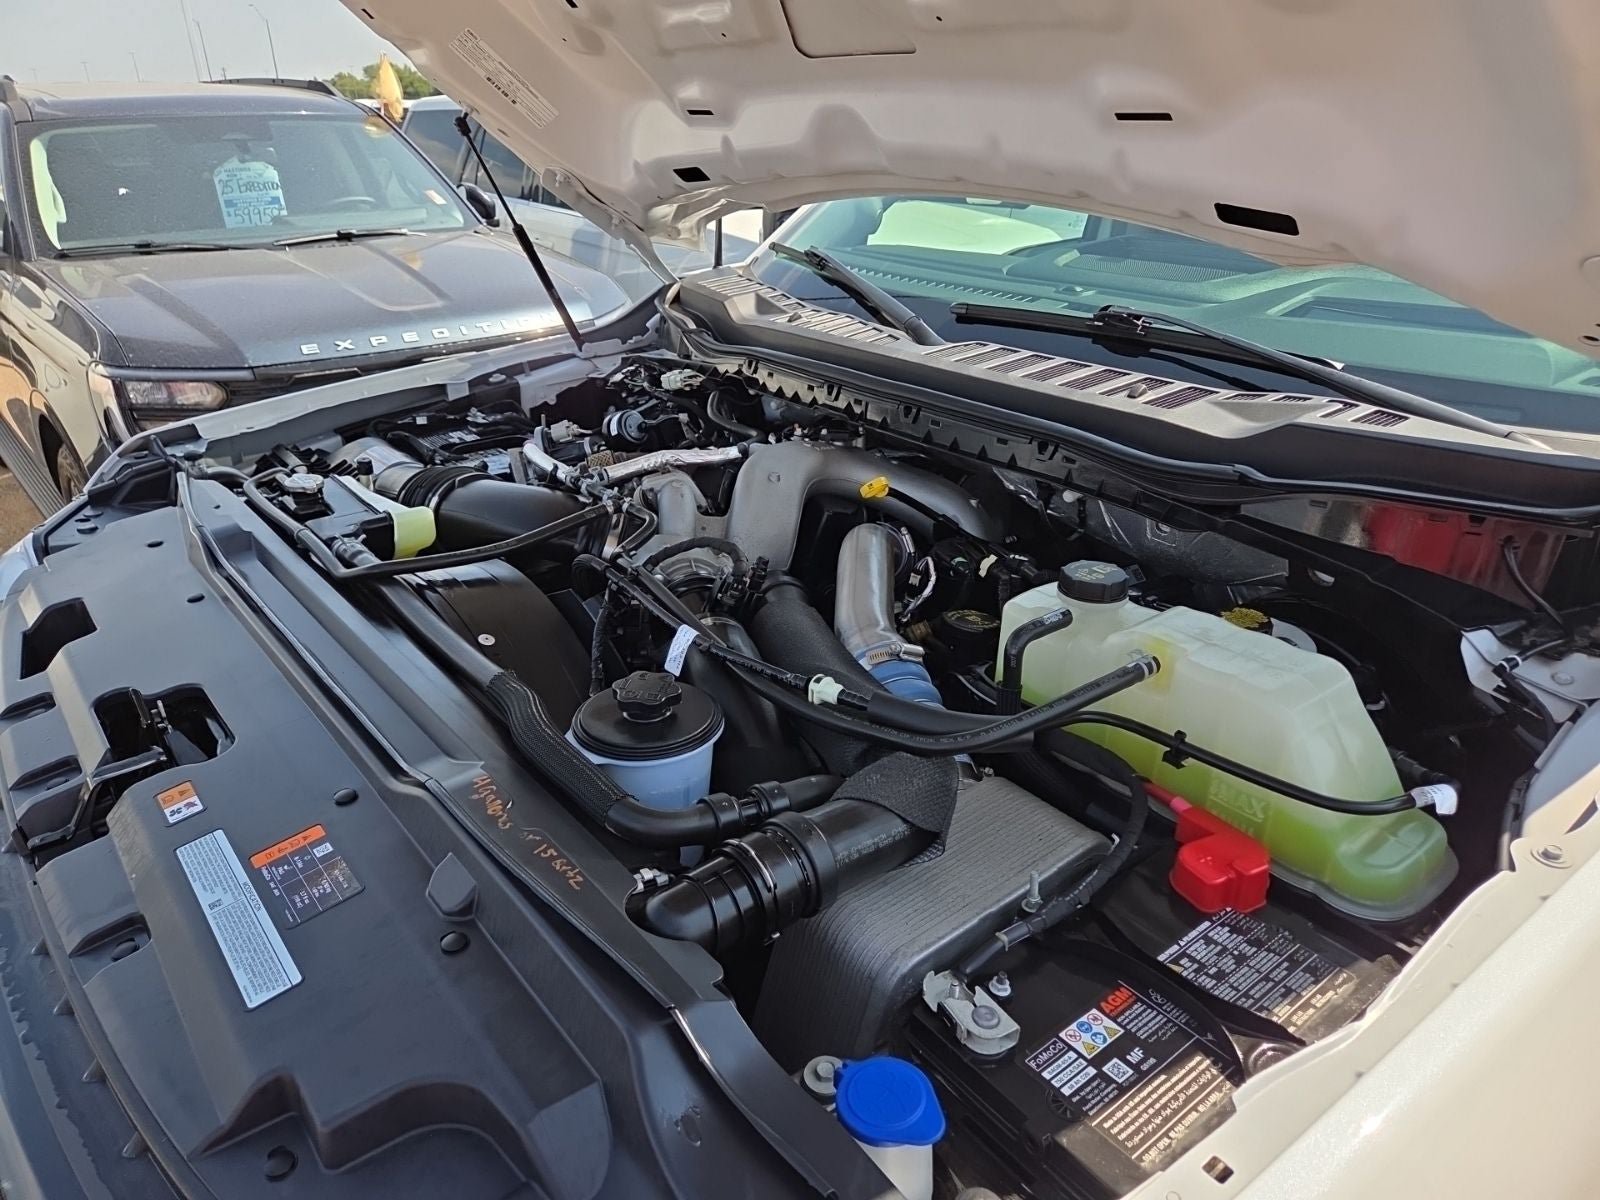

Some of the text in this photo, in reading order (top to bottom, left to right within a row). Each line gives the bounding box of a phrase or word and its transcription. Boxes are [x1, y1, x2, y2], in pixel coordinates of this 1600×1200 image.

[300, 311, 561, 355] EXPEDITION
[533, 843, 558, 858] 15
[243, 882, 262, 912] MODIFICATION
[1101, 985, 1133, 1014] AGM
[1029, 1041, 1064, 1068] FoMoCo
[1124, 1046, 1147, 1064] MF
